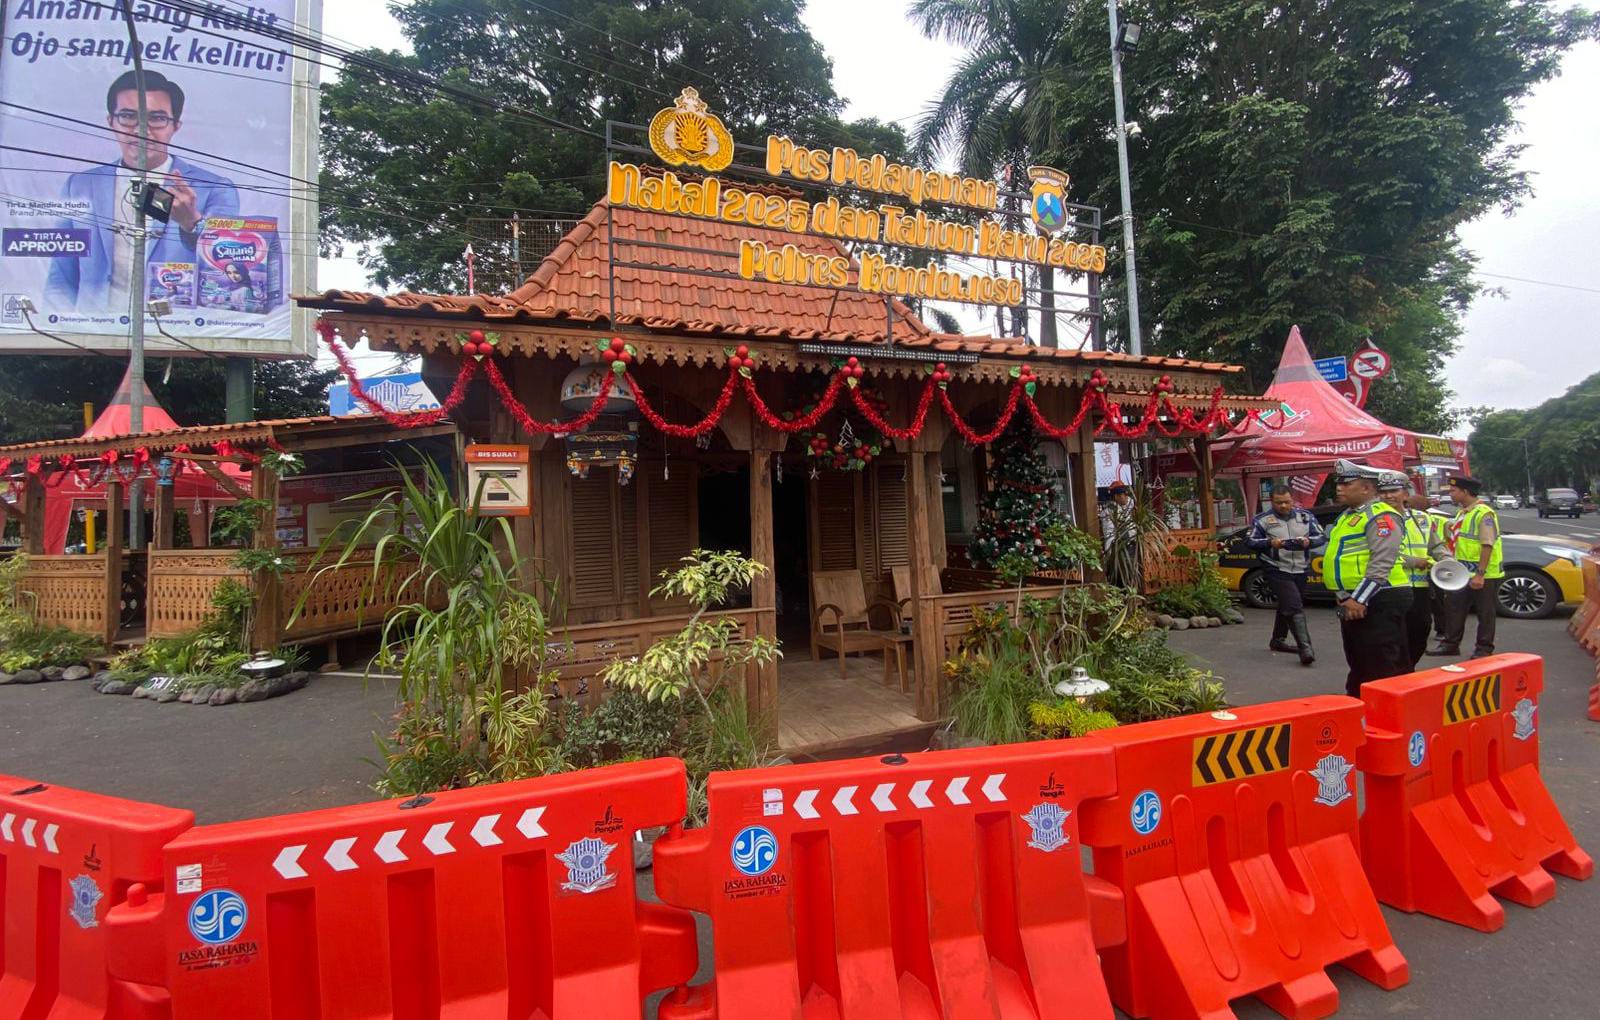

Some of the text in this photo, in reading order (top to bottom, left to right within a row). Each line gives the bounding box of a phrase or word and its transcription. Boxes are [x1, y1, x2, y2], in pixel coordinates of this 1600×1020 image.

[14, 0, 101, 20] Aman
[11, 31, 287, 72] Ojo sampek keliru!
[766, 134, 997, 211] Pos Pelayanan
[607, 161, 721, 218] Natal
[721, 188, 810, 234] 2025
[812, 196, 880, 242] dan
[880, 204, 975, 254] Tahun
[978, 218, 1048, 264] Baru
[33, 232, 63, 240] TIRTA
[7, 241, 86, 252] APPROVED
[738, 239, 1023, 306] Polres Bondowoso
[1302, 440, 1371, 455] bankjatim
[594, 824, 624, 834] Penguin
[724, 873, 787, 893] JASA RAHARJA
[206, 942, 258, 958] RAHARJA
